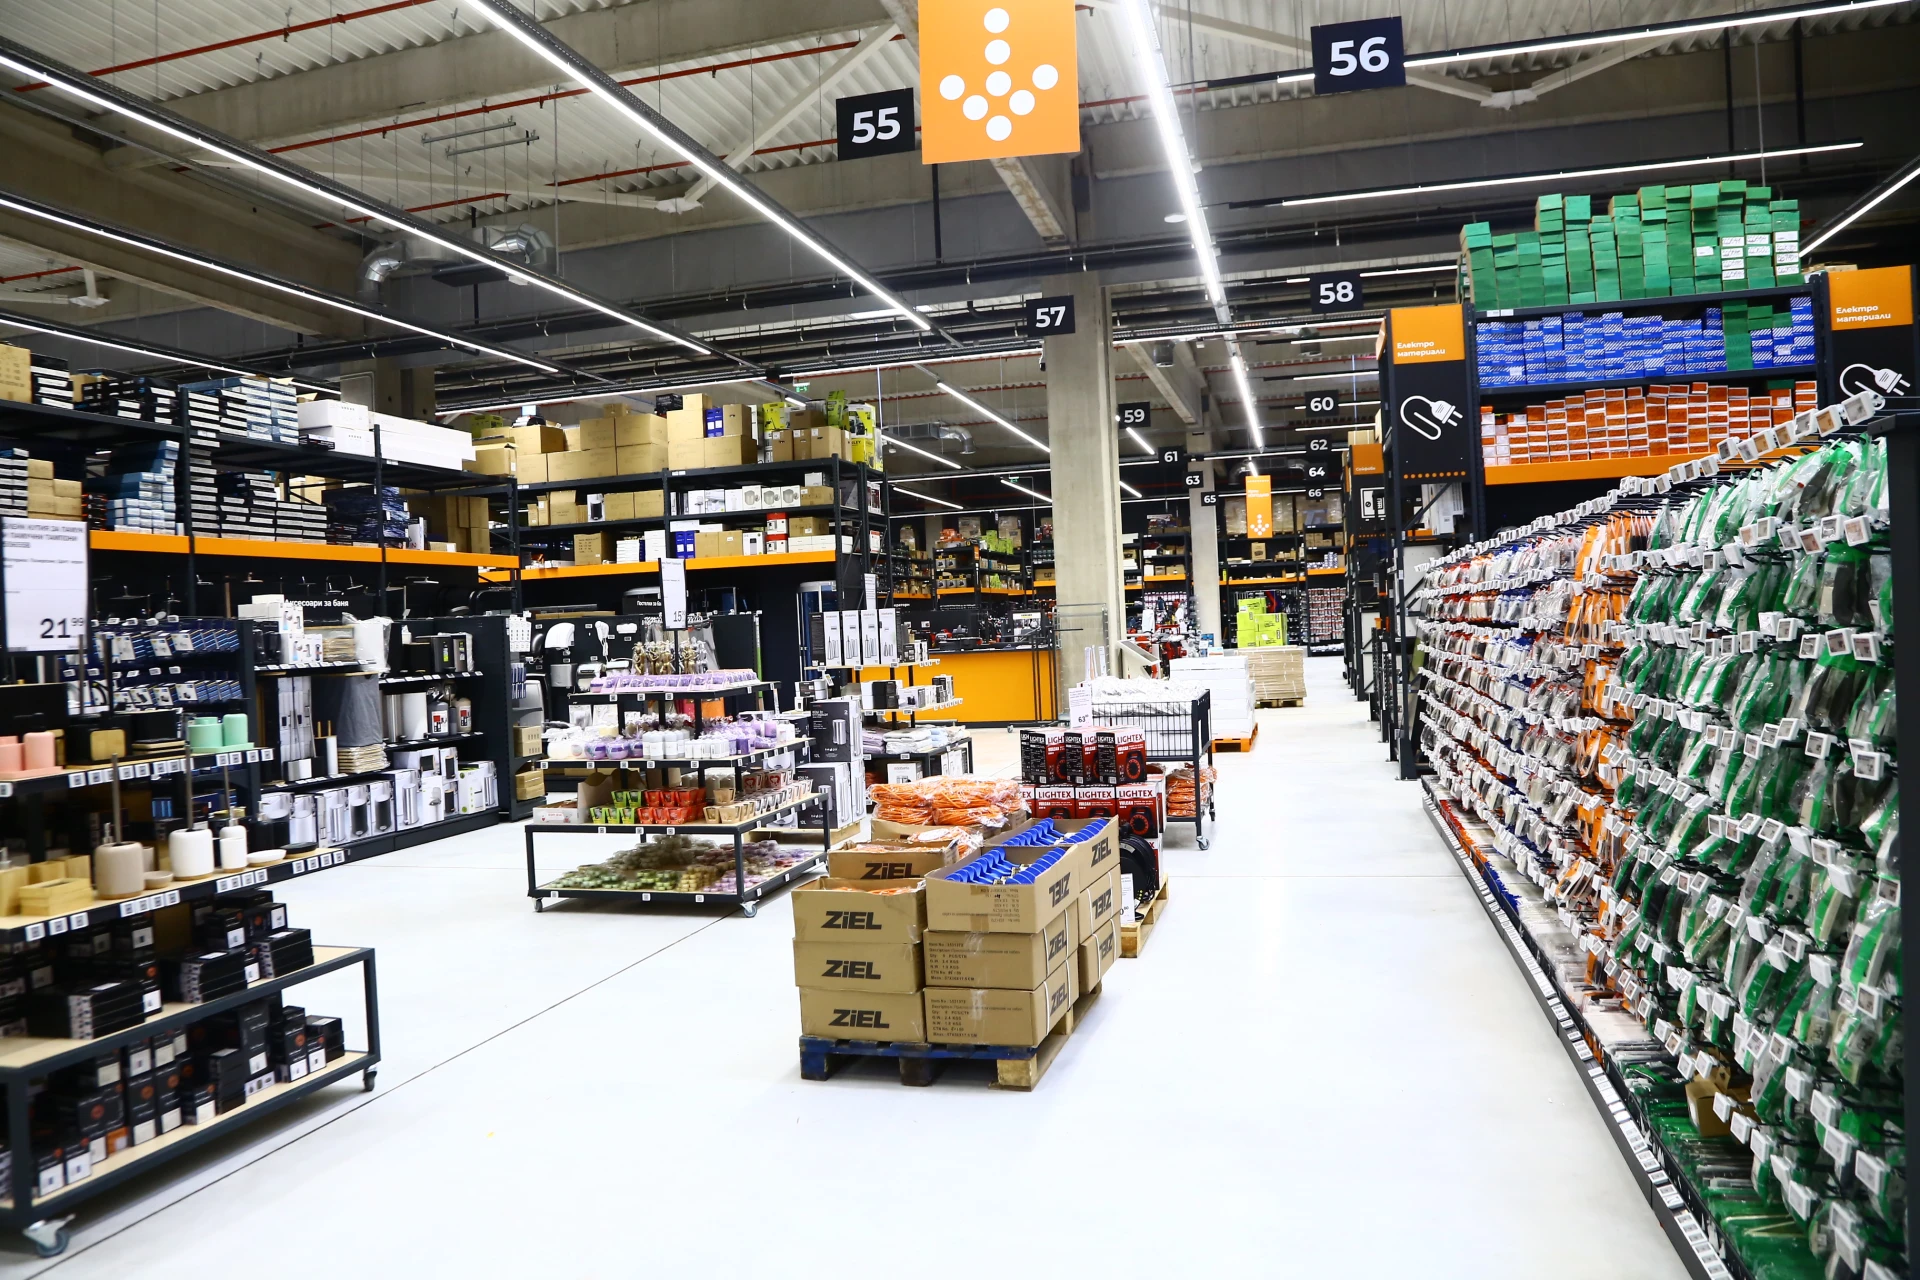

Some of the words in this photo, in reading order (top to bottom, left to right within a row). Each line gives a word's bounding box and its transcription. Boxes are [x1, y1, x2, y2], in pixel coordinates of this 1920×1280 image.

[1329, 36, 1390, 76] 56
[851, 106, 900, 144] 55
[1319, 281, 1354, 305] 58
[1836, 305, 1879, 314] Електро
[1035, 305, 1066, 328] 57
[1836, 313, 1892, 323] материали
[1397, 341, 1435, 349] Електро
[1397, 349, 1446, 357] материали
[1310, 396, 1334, 412] 60
[1124, 408, 1145, 424] 59
[1310, 439, 1328, 451] 62
[1164, 450, 1178, 462] 61
[1308, 466, 1326, 478] 64
[1185, 475, 1201, 486] 63
[1203, 494, 1217, 504] 65
[1308, 488, 1322, 498] 66
[333, 599, 349, 607] баня
[673, 610, 682, 622] 15
[40, 618, 71, 639] 21
[1117, 733, 1143, 744] LIGHTEX
[1118, 789, 1153, 798] LIGHTEX
[860, 862, 921, 880] ZiEL
[820, 910, 883, 930] ZiEL
[821, 959, 882, 980] ZiEL
[827, 1008, 890, 1029] ZiEL
